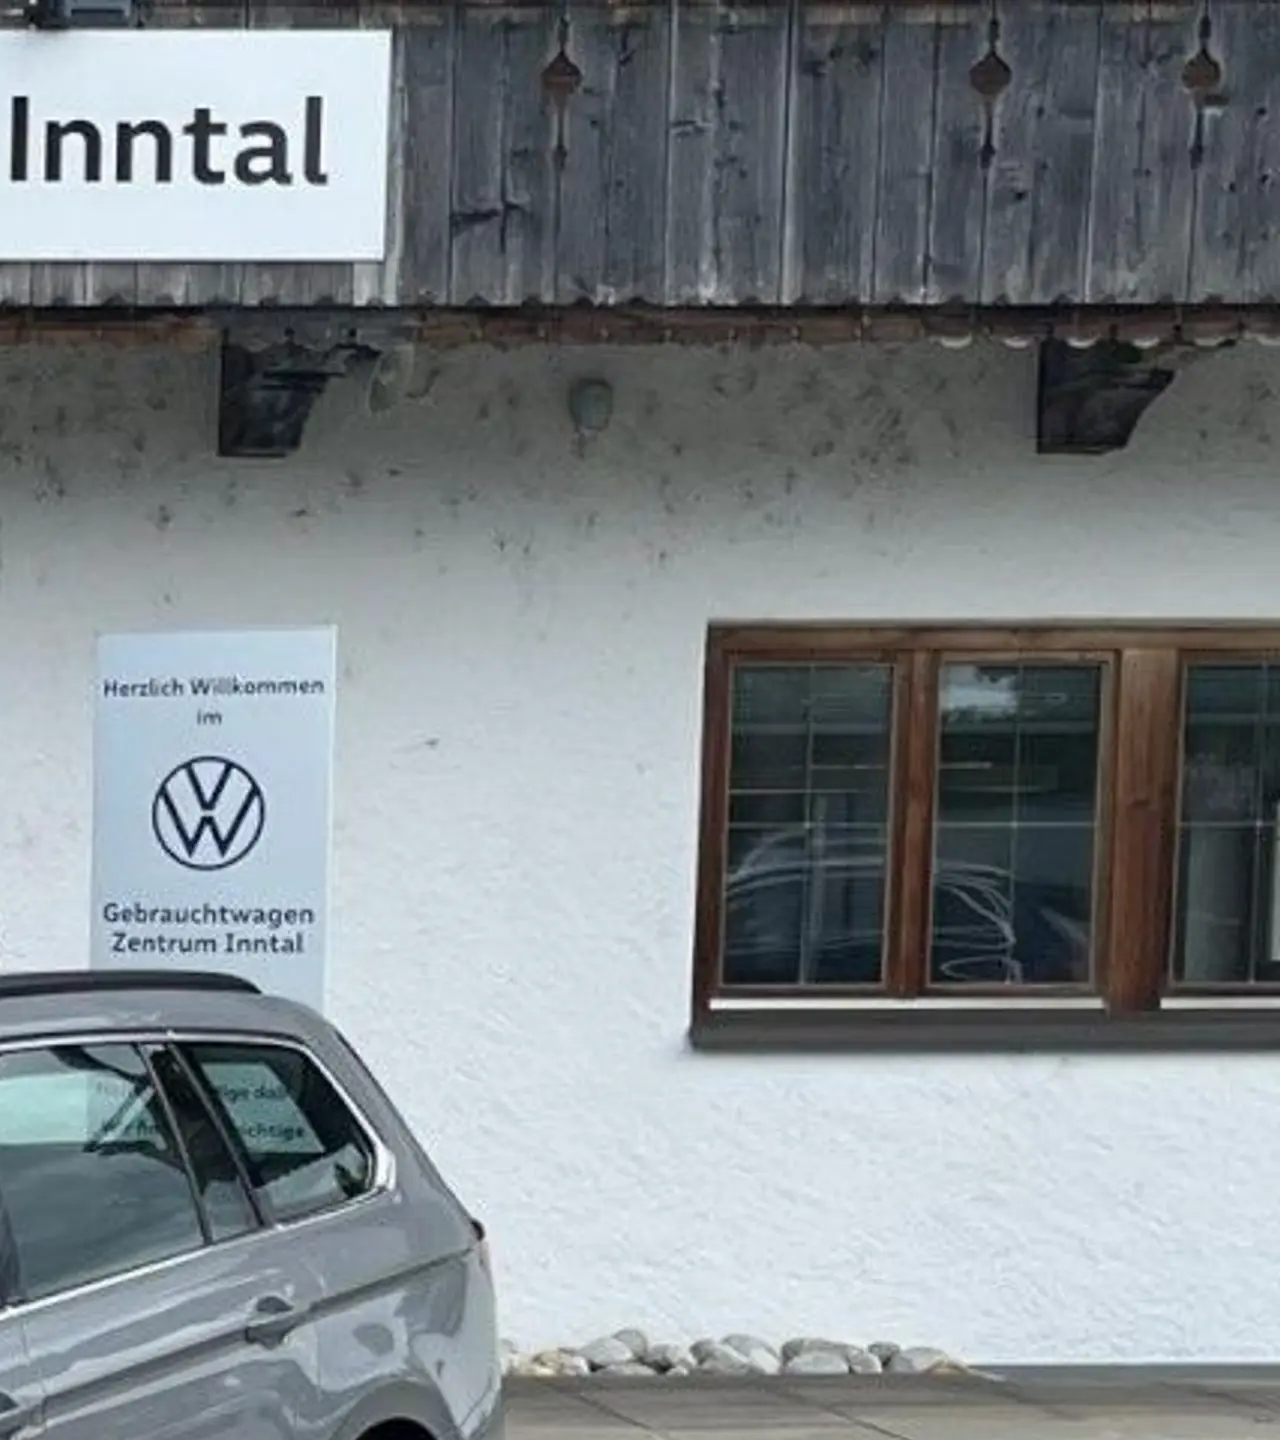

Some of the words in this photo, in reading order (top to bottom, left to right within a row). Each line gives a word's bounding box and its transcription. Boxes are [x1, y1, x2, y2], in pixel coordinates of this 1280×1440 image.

[9, 95, 329, 186] Inntal
[103, 678, 184, 698] Herzlich
[190, 676, 326, 697] Willkommen
[196, 708, 223, 726] im
[102, 902, 315, 926] Gebrauchtwagen
[110, 931, 217, 954] Zentrum
[225, 931, 305, 954] Inntal
